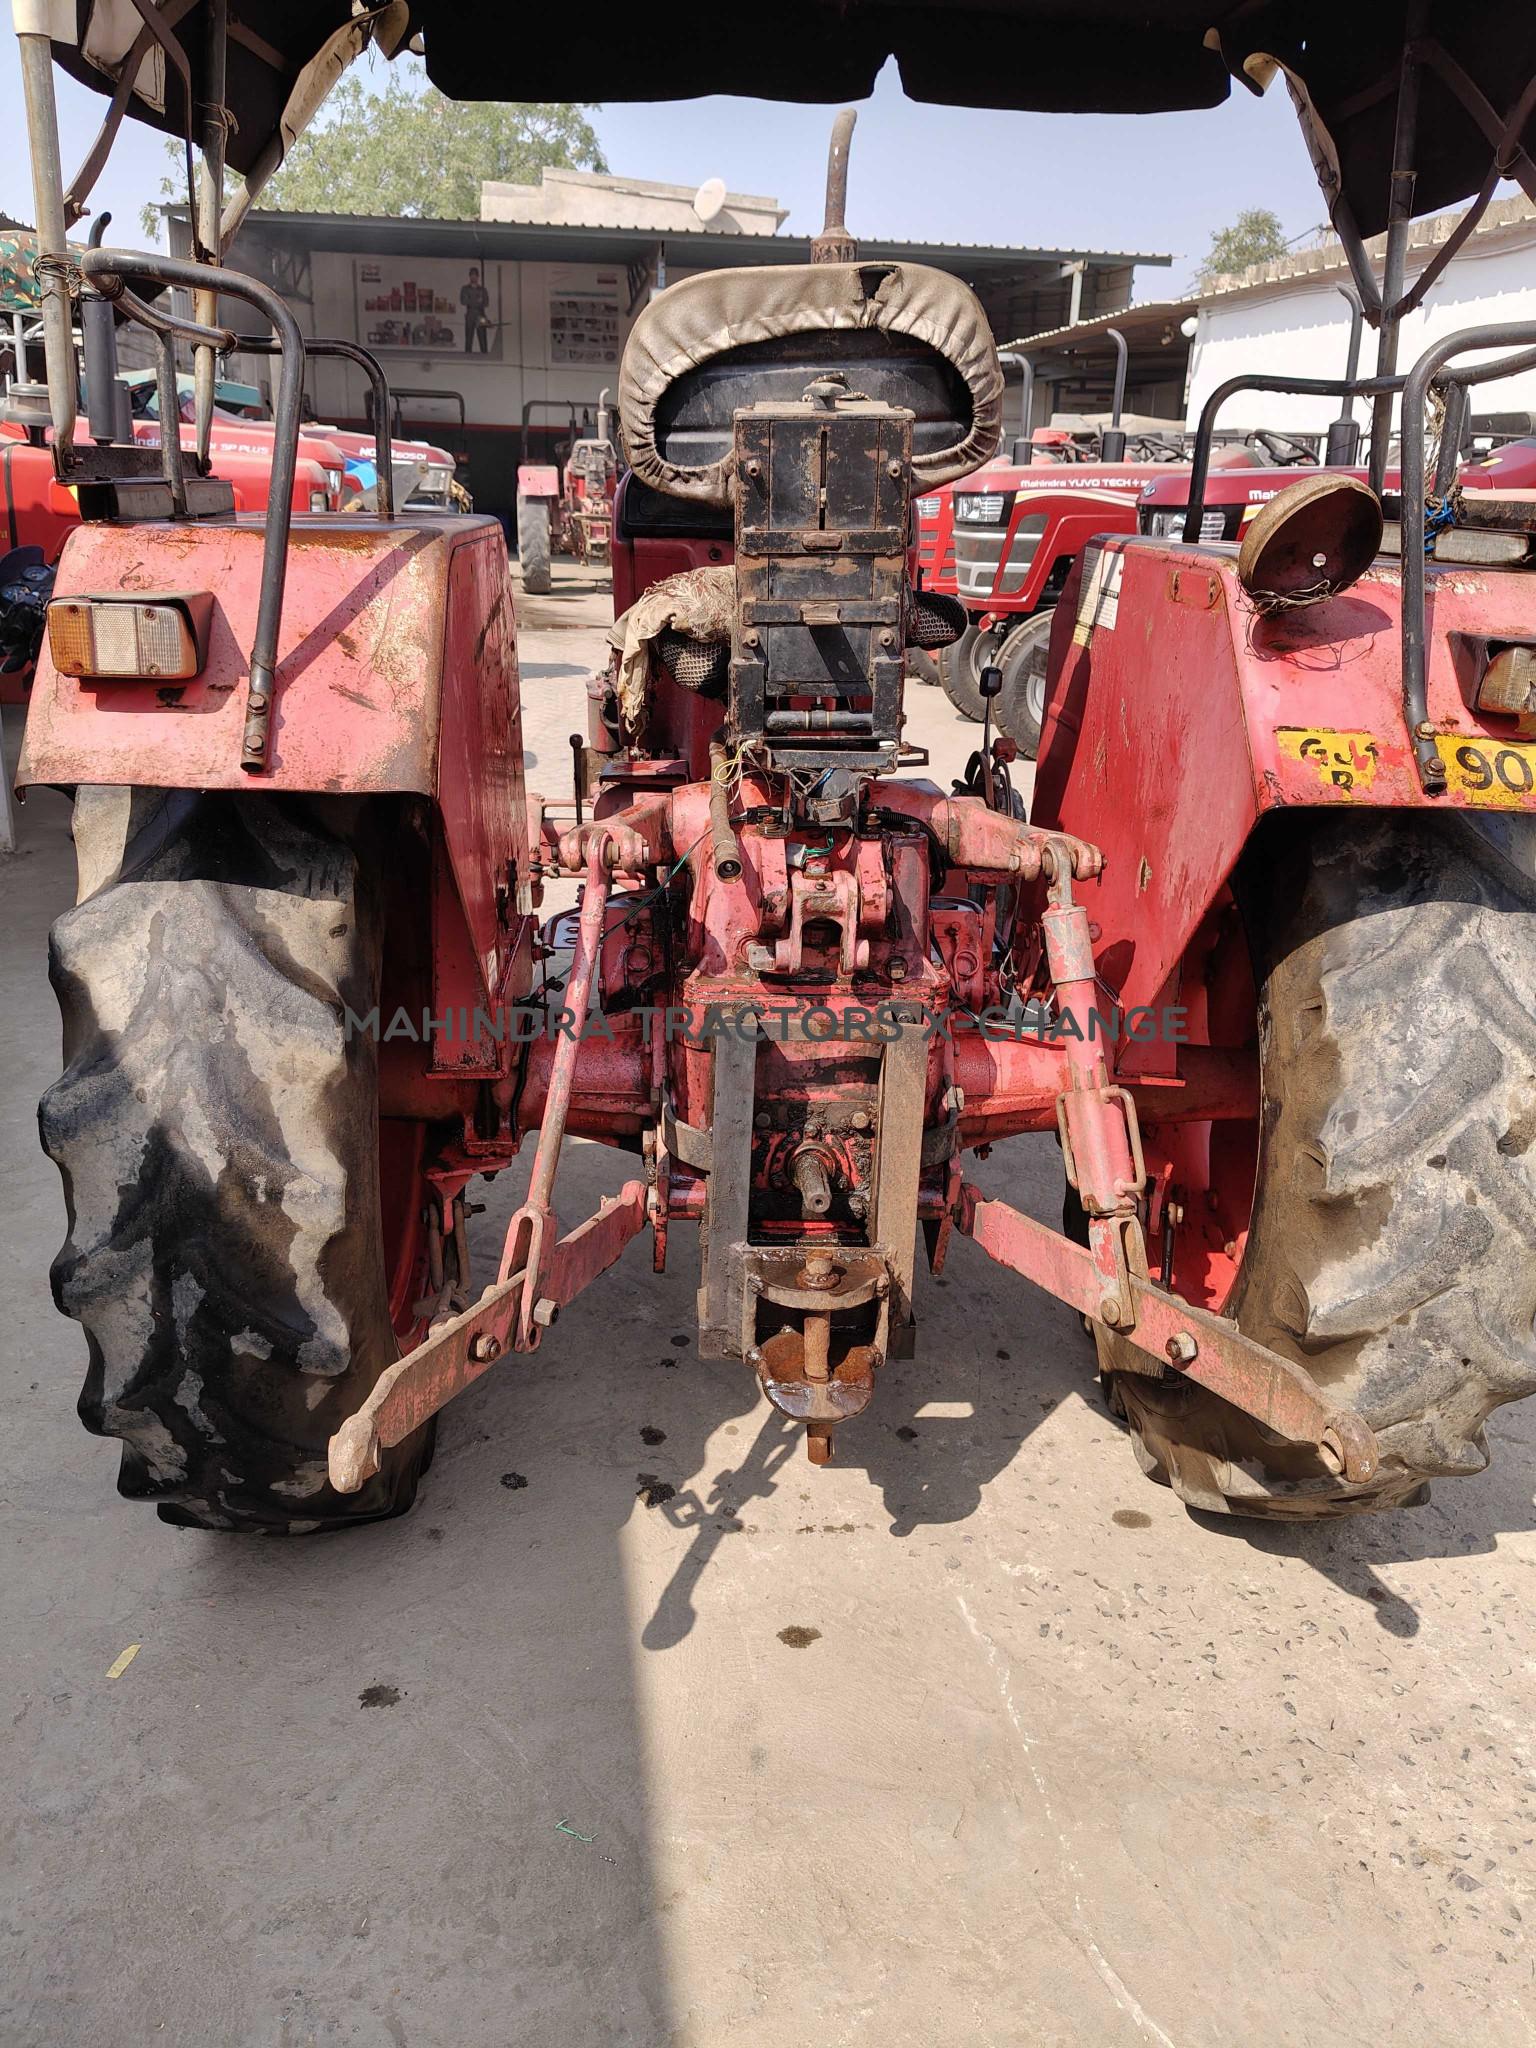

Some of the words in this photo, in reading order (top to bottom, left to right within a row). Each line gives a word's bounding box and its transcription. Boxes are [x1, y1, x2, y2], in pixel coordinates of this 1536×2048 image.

[220, 443, 237, 451] SP
[238, 444, 269, 454] PLUS
[1020, 479, 1067, 488] Mahindra
[1068, 478, 1101, 488] YUVO
